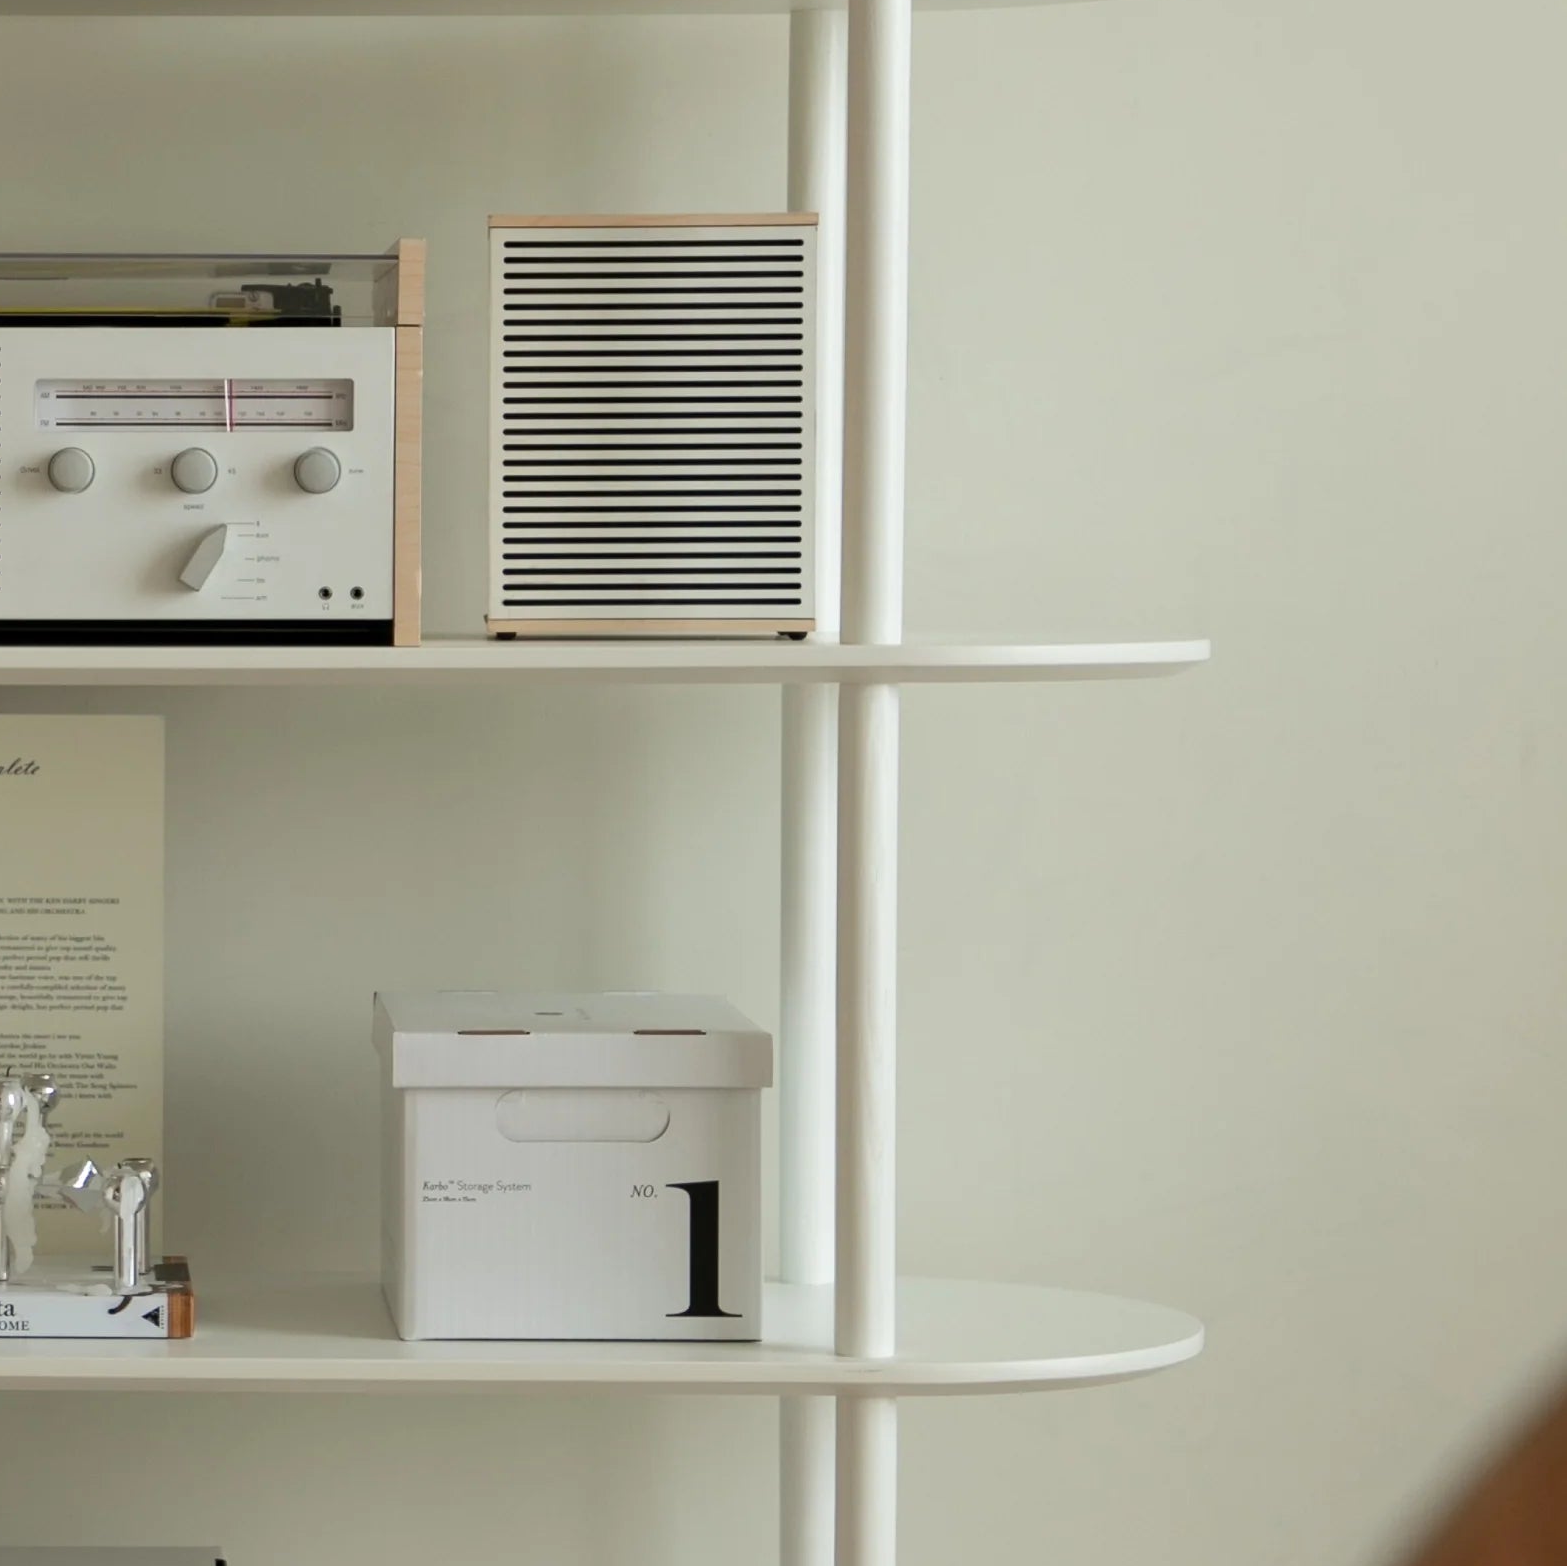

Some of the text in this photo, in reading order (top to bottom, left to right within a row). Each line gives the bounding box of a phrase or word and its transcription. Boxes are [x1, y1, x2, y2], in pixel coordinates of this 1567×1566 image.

[457, 1180, 494, 1194] Storage
[496, 1180, 532, 1193] System
[630, 1185, 658, 1199] NO.
[666, 1180, 742, 1318] 1
